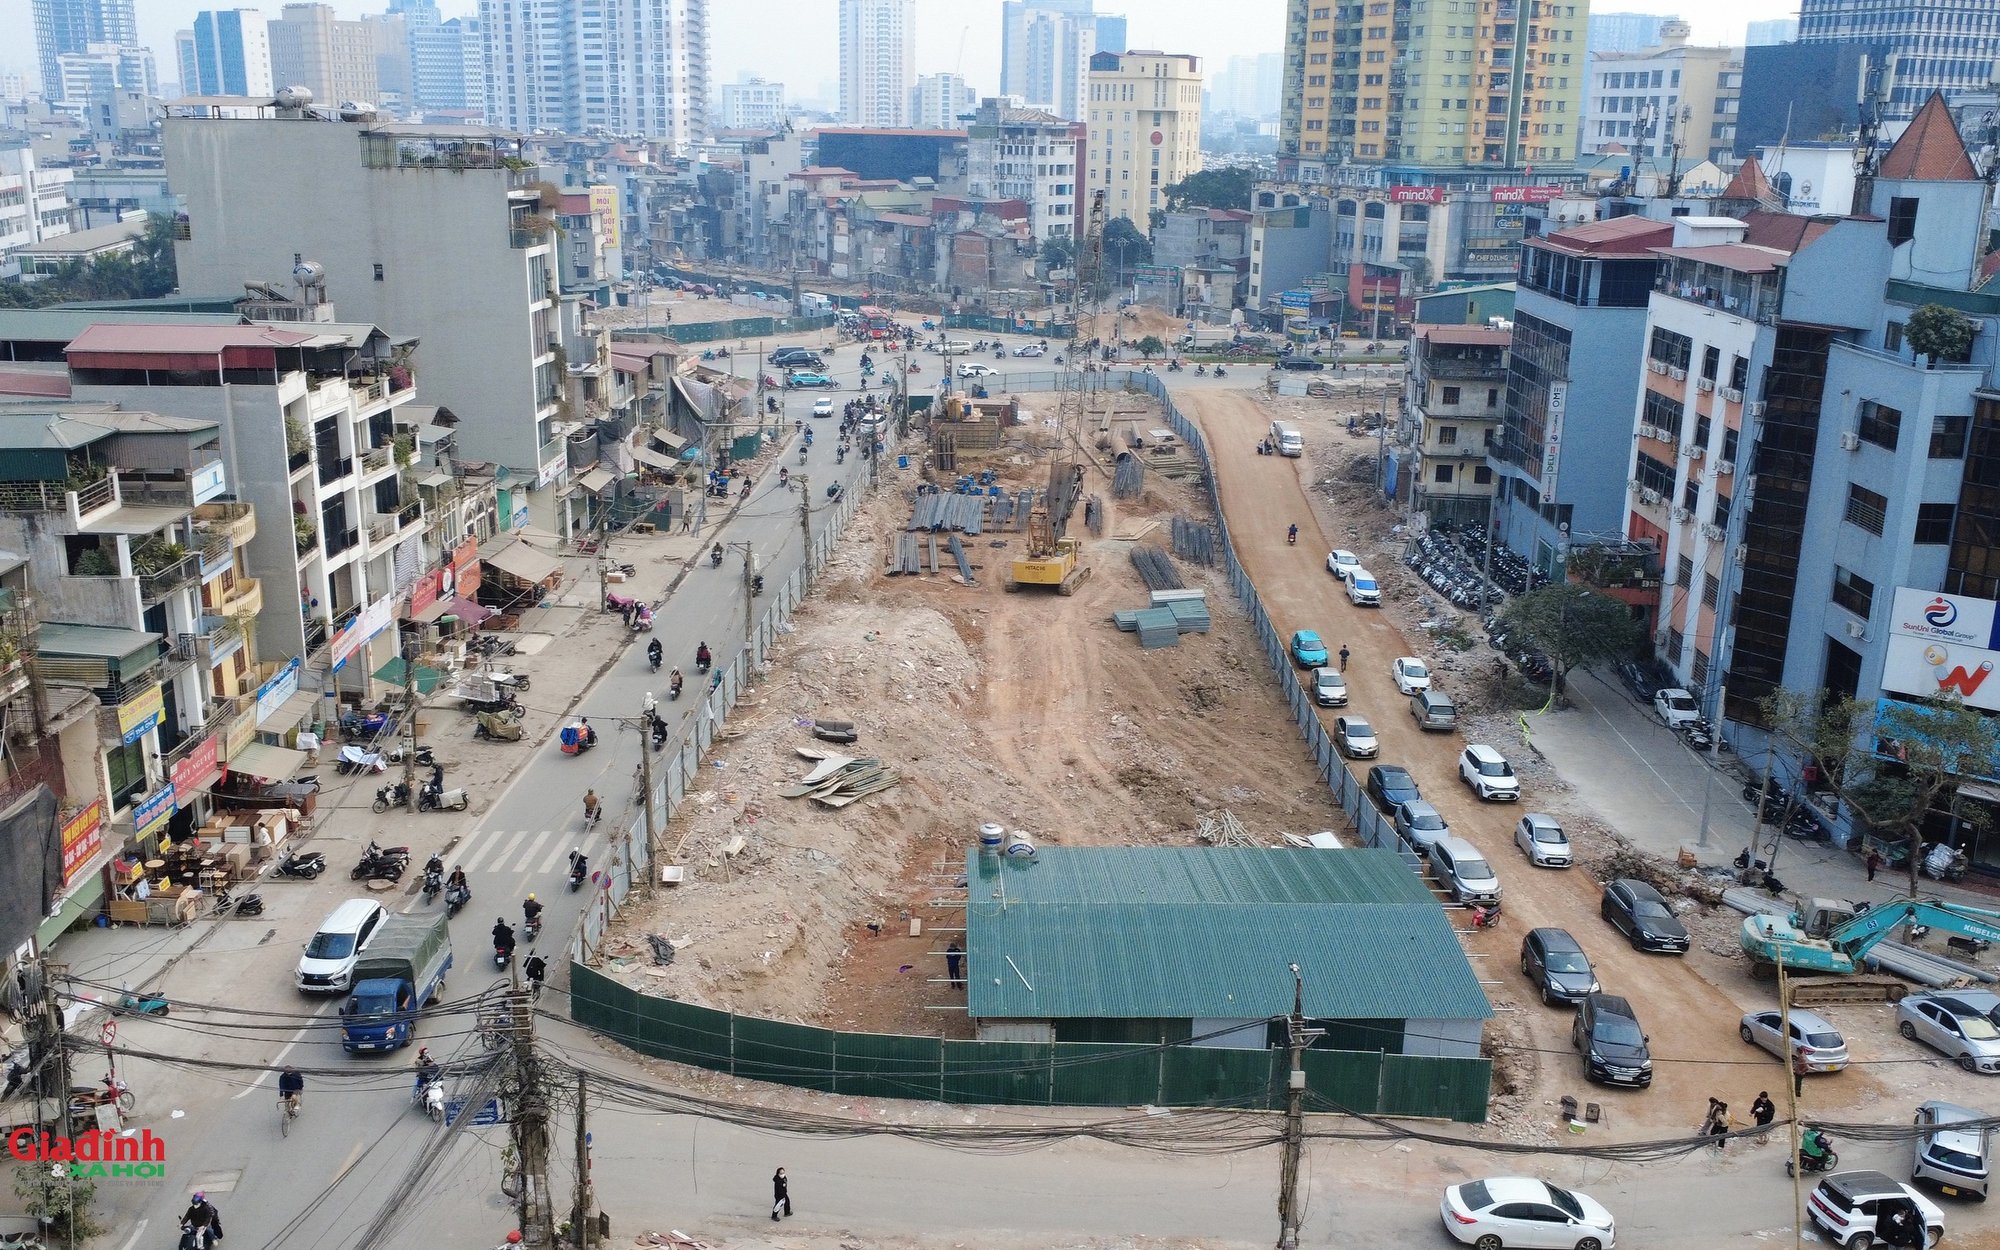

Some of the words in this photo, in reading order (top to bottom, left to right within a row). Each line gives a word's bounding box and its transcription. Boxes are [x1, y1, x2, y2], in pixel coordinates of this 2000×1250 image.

[1398, 188, 1435, 200] mindX
[1495, 188, 1525, 200] mindX
[1903, 622, 1930, 633] SunUni
[1930, 627, 1955, 637] Global
[1955, 632, 1974, 640] Group
[1867, 921, 1877, 929] 63
[1963, 924, 2000, 940] KOBELCO
